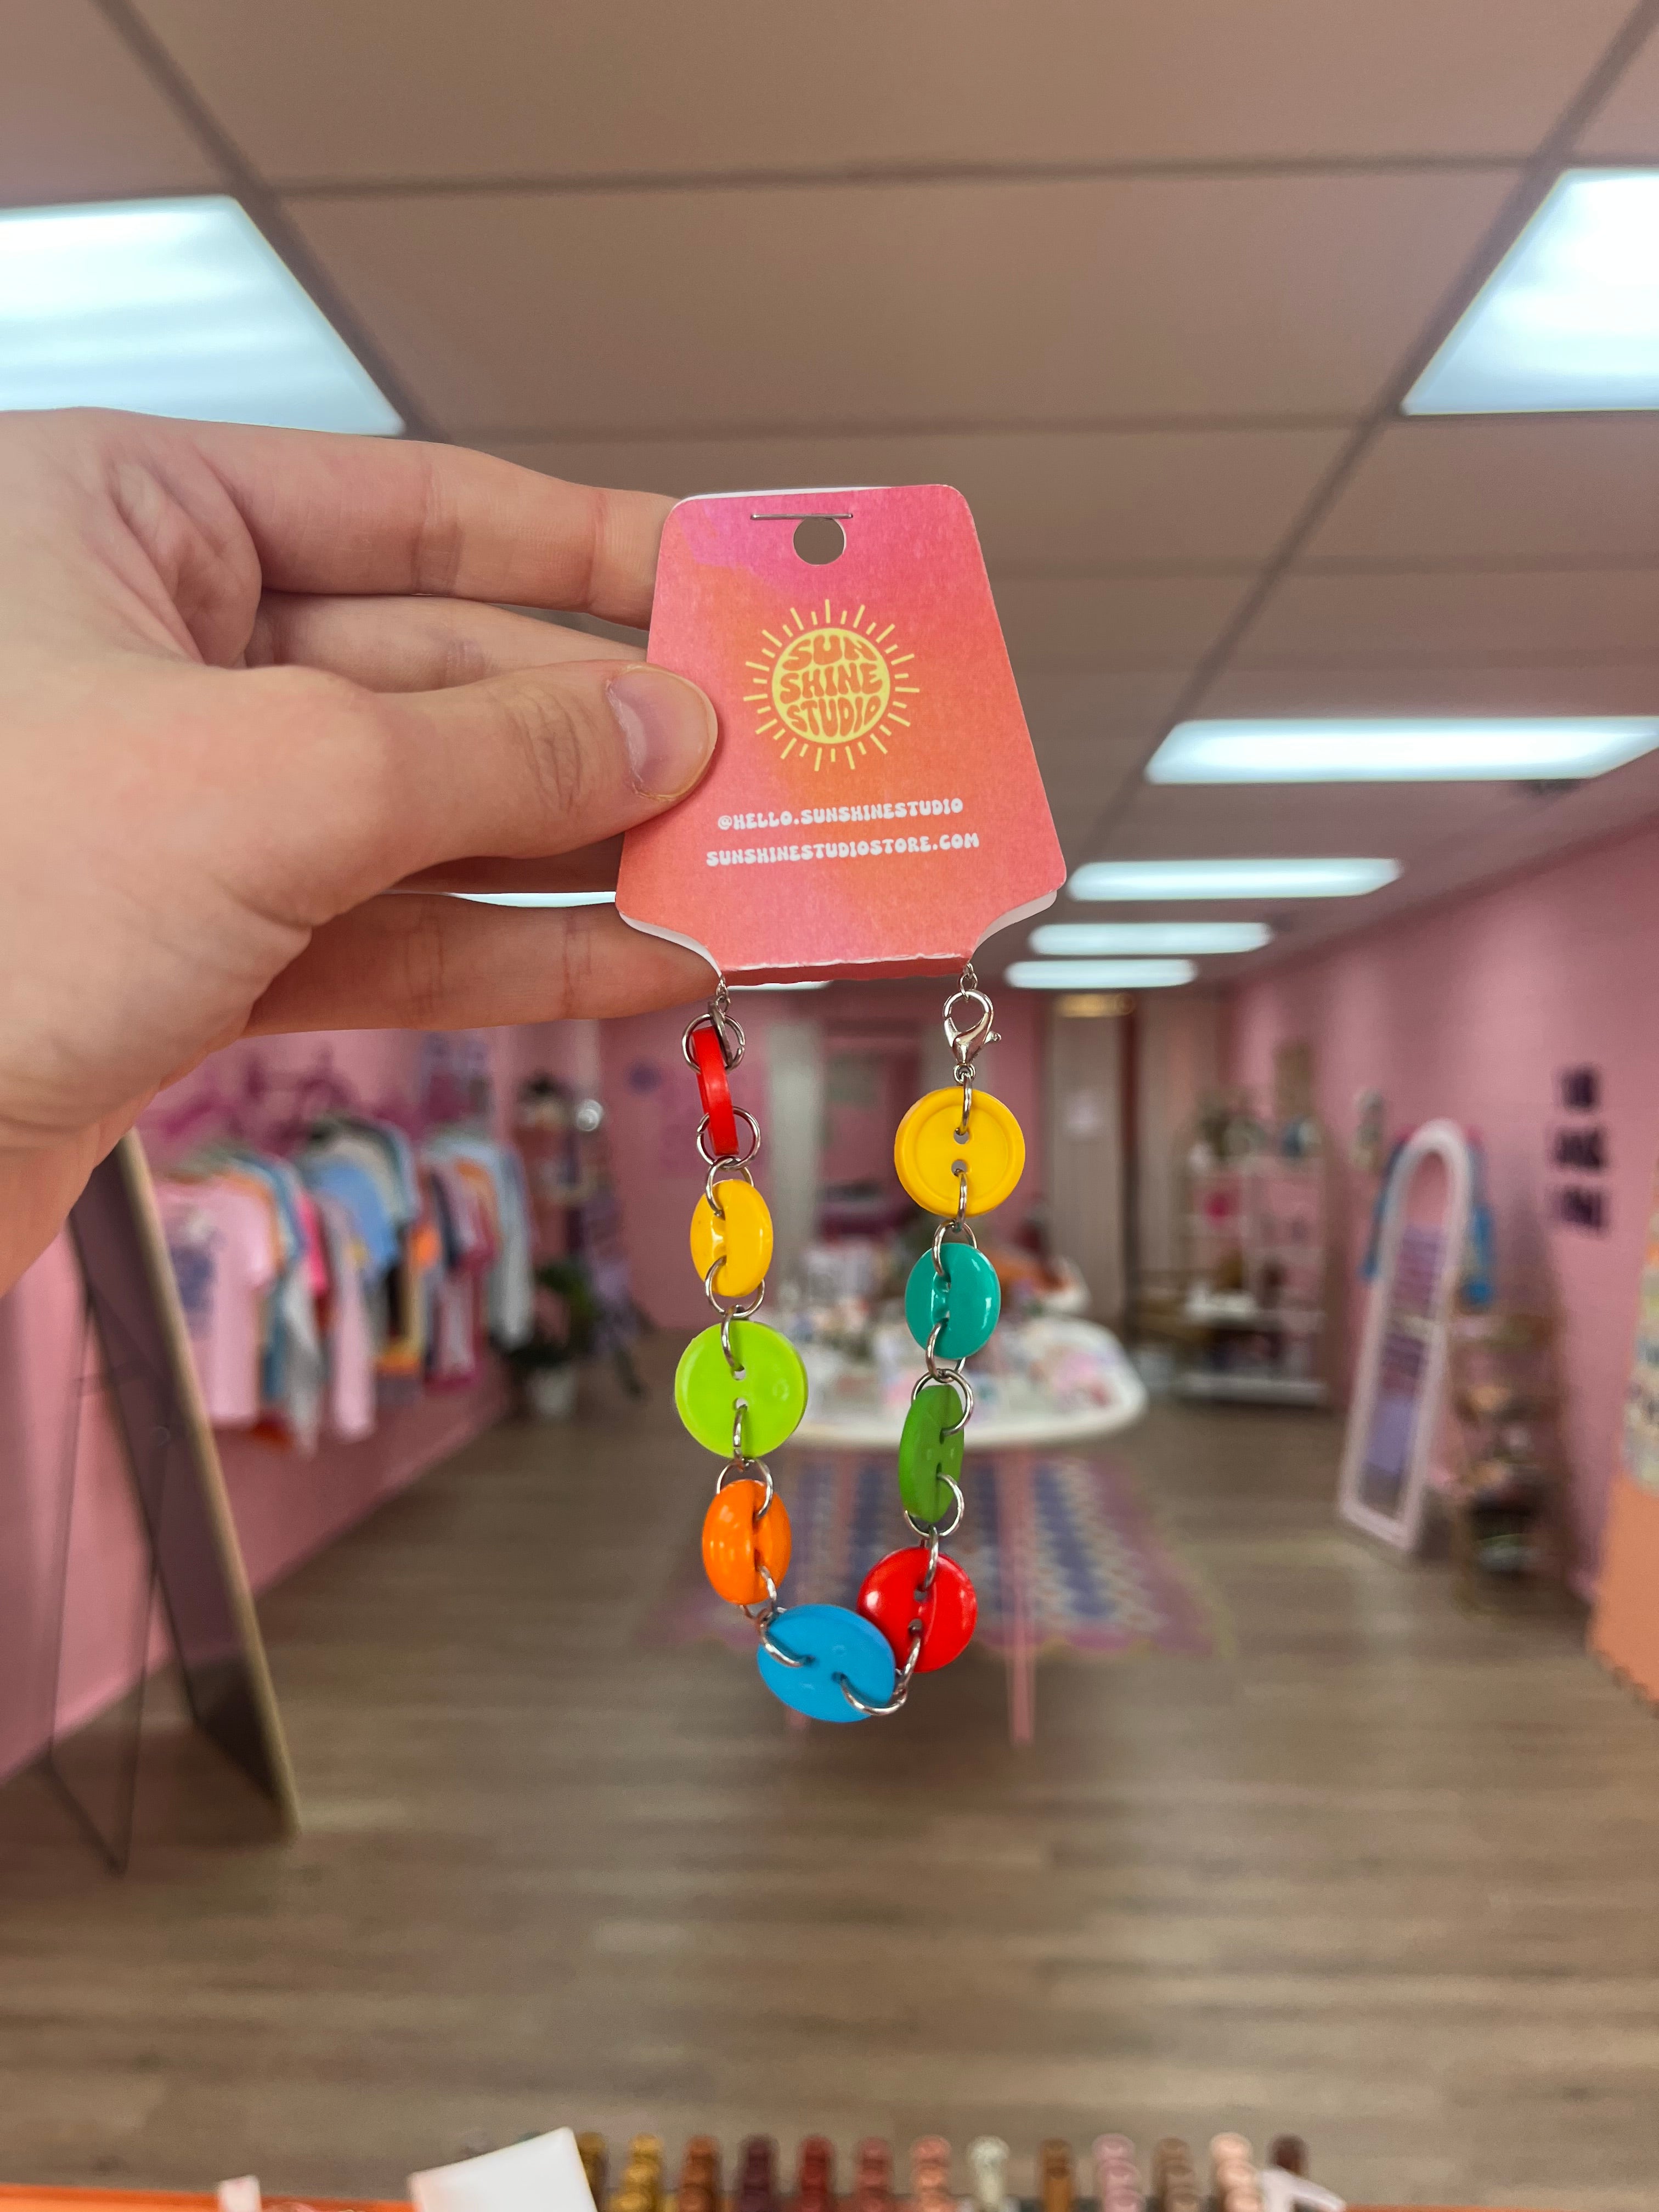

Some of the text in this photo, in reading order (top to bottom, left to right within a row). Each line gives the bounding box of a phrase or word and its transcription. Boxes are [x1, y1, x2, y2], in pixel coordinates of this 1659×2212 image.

[782, 635, 878, 670] SUN
[780, 663, 883, 704] SHINE
[786, 696, 882, 737] STUDIO
[718, 798, 963, 830] @HELLO.SUNSHINESTUDIO
[706, 833, 979, 867] SUNSHINESTUDIOSTORE.COM
